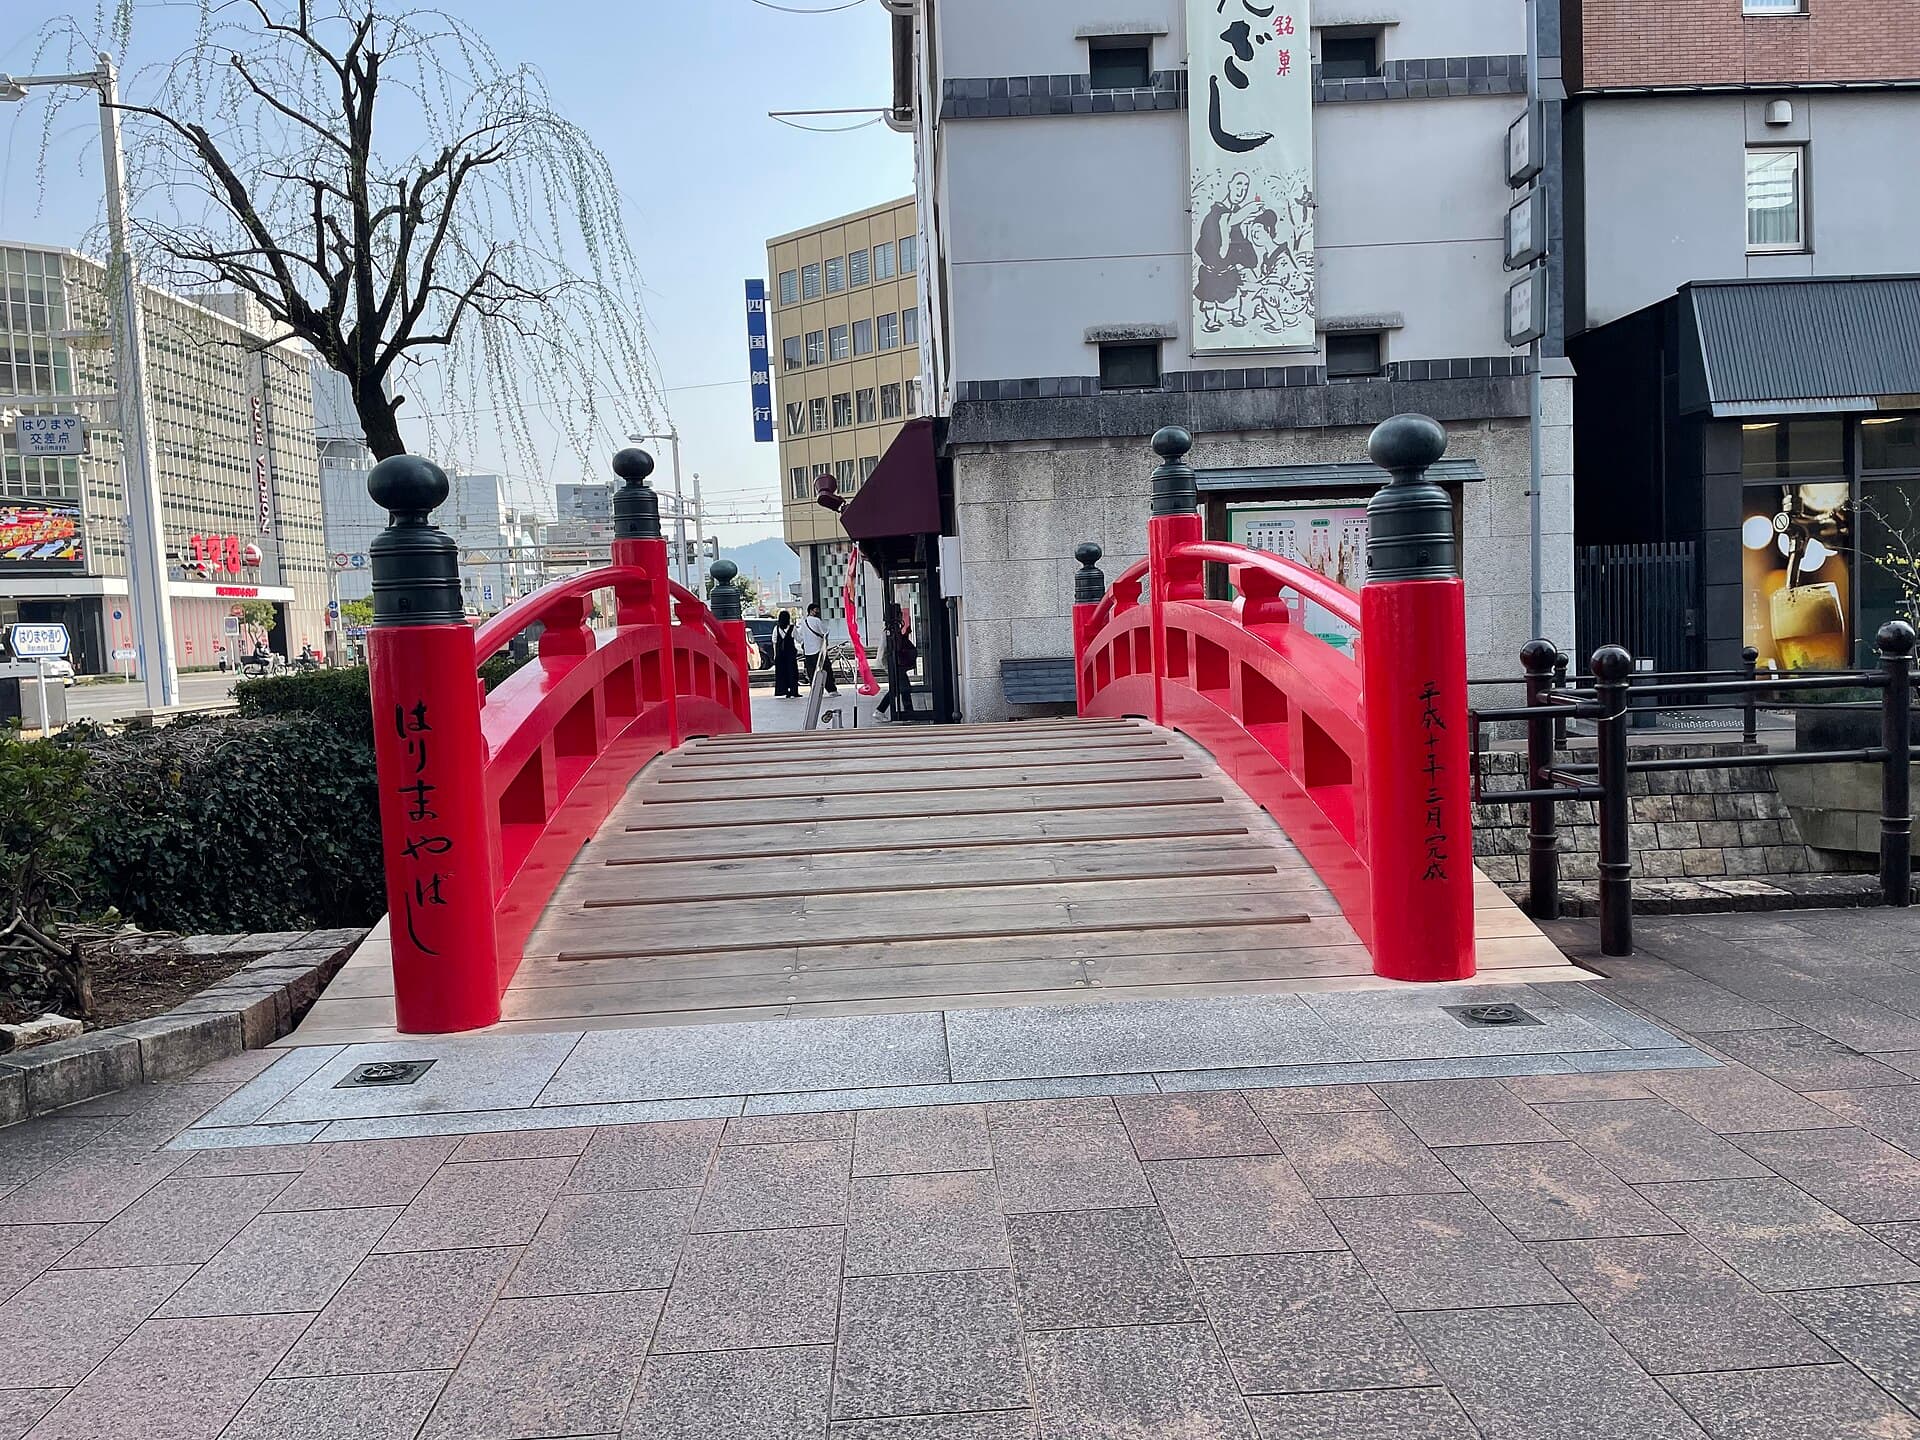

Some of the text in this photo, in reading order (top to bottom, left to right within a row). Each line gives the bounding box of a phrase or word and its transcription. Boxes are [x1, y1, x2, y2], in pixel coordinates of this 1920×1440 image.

[1272, 15, 1295, 77] 銘菓
[748, 299, 771, 422] 四国銀行
[22, 418, 76, 431] はりまや
[31, 432, 70, 445] 交差点
[19, 630, 61, 643] はりまや通り
[1418, 681, 1448, 881] 平成十年三月完成
[395, 700, 456, 955] はりまやばし
